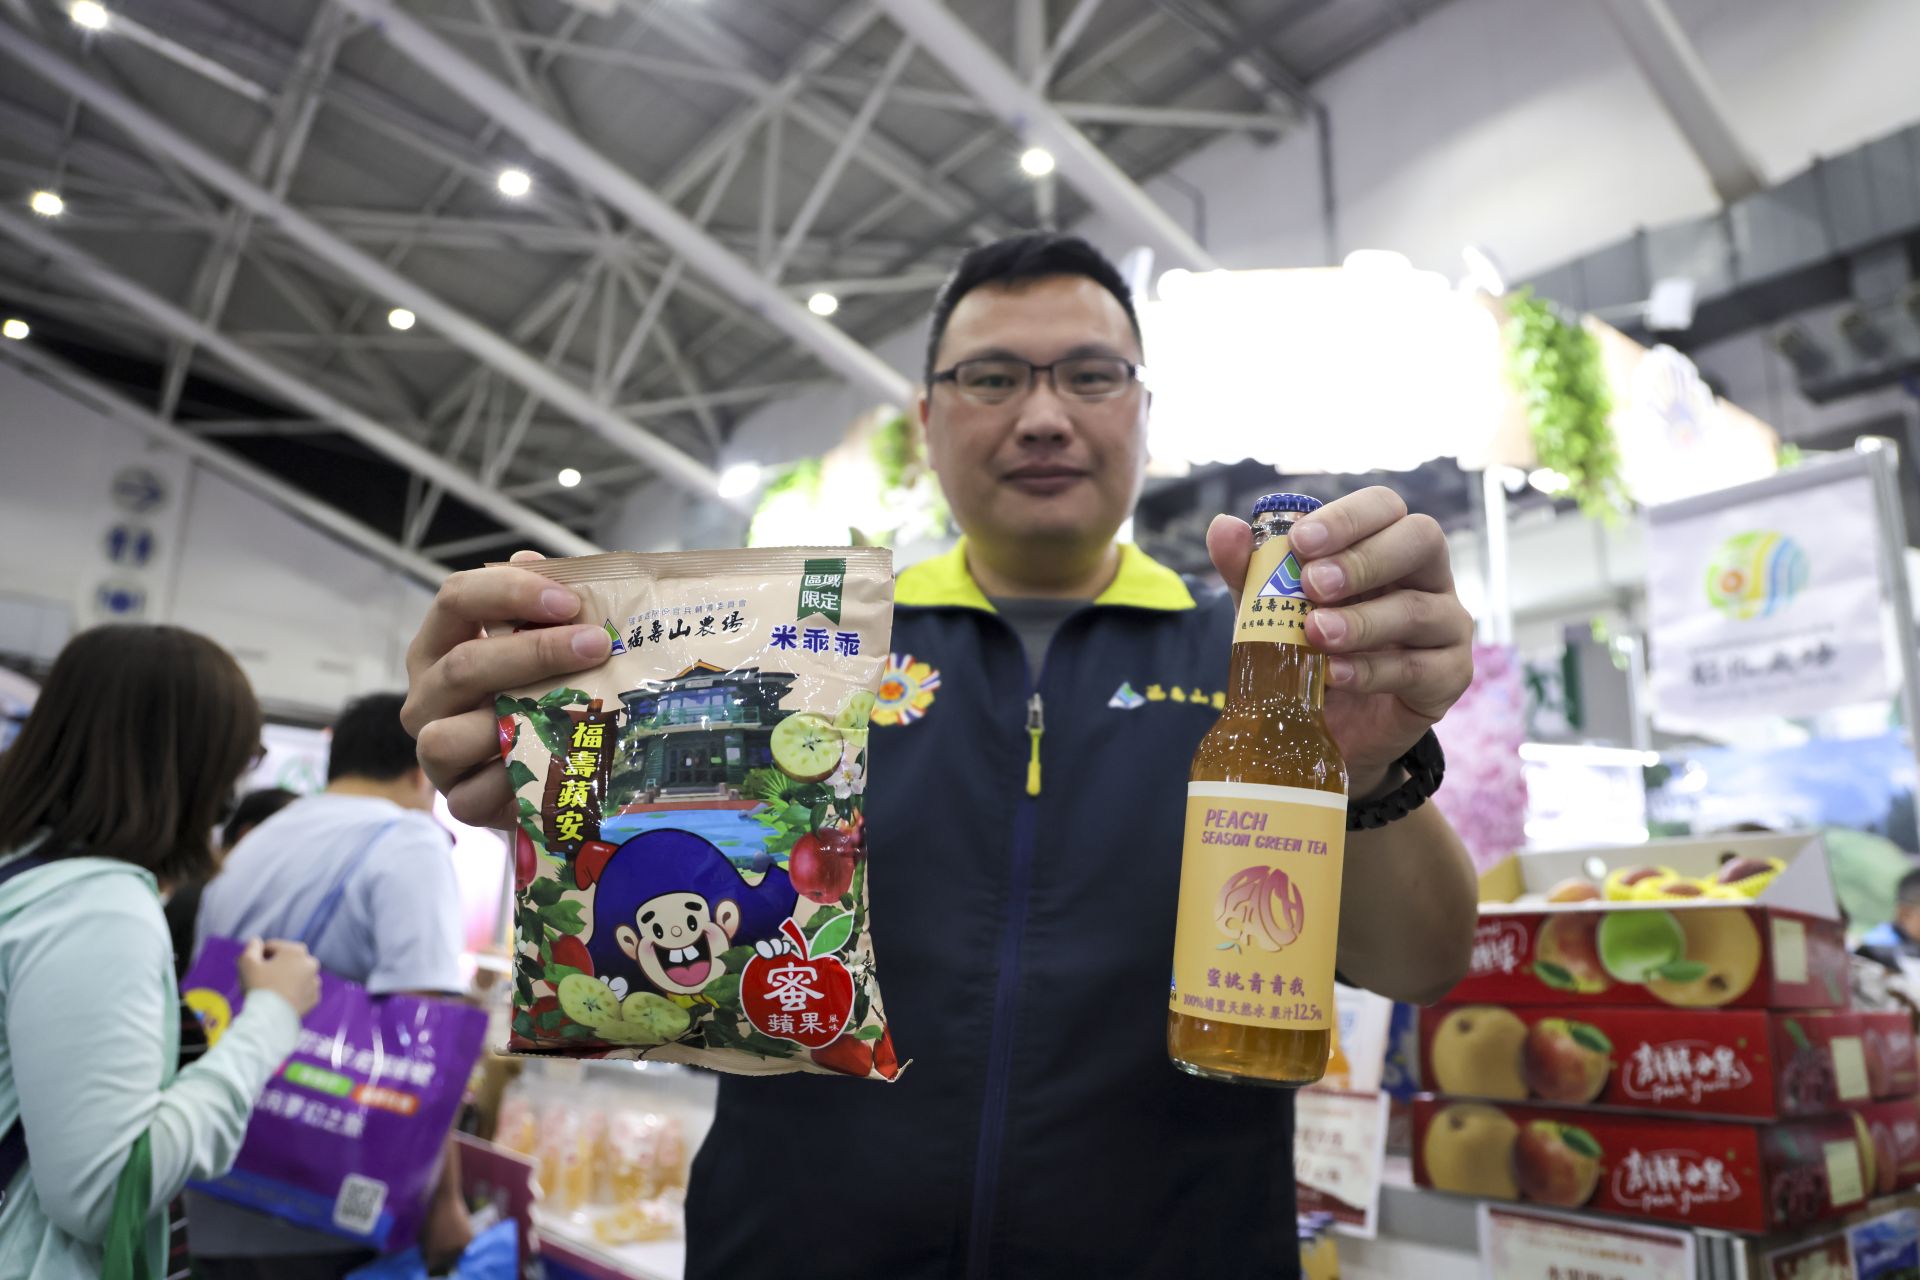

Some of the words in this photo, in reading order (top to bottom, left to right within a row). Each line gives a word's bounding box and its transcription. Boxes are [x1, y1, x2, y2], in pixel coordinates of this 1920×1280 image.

[803, 574, 842, 589] 區域
[801, 590, 839, 611] 限定
[769, 624, 861, 658] 米乖乖
[556, 722, 606, 842] 福壽蘋安
[1204, 808, 1269, 832] PEACH
[1201, 830, 1251, 848] SEASON
[1254, 834, 1303, 852] GREEN
[1306, 839, 1328, 856] TEA
[763, 961, 825, 1012] 蜜
[1207, 967, 1305, 997] 蜜桃青青我
[767, 1012, 827, 1034] 蘋果
[828, 1014, 839, 1032] 風味
